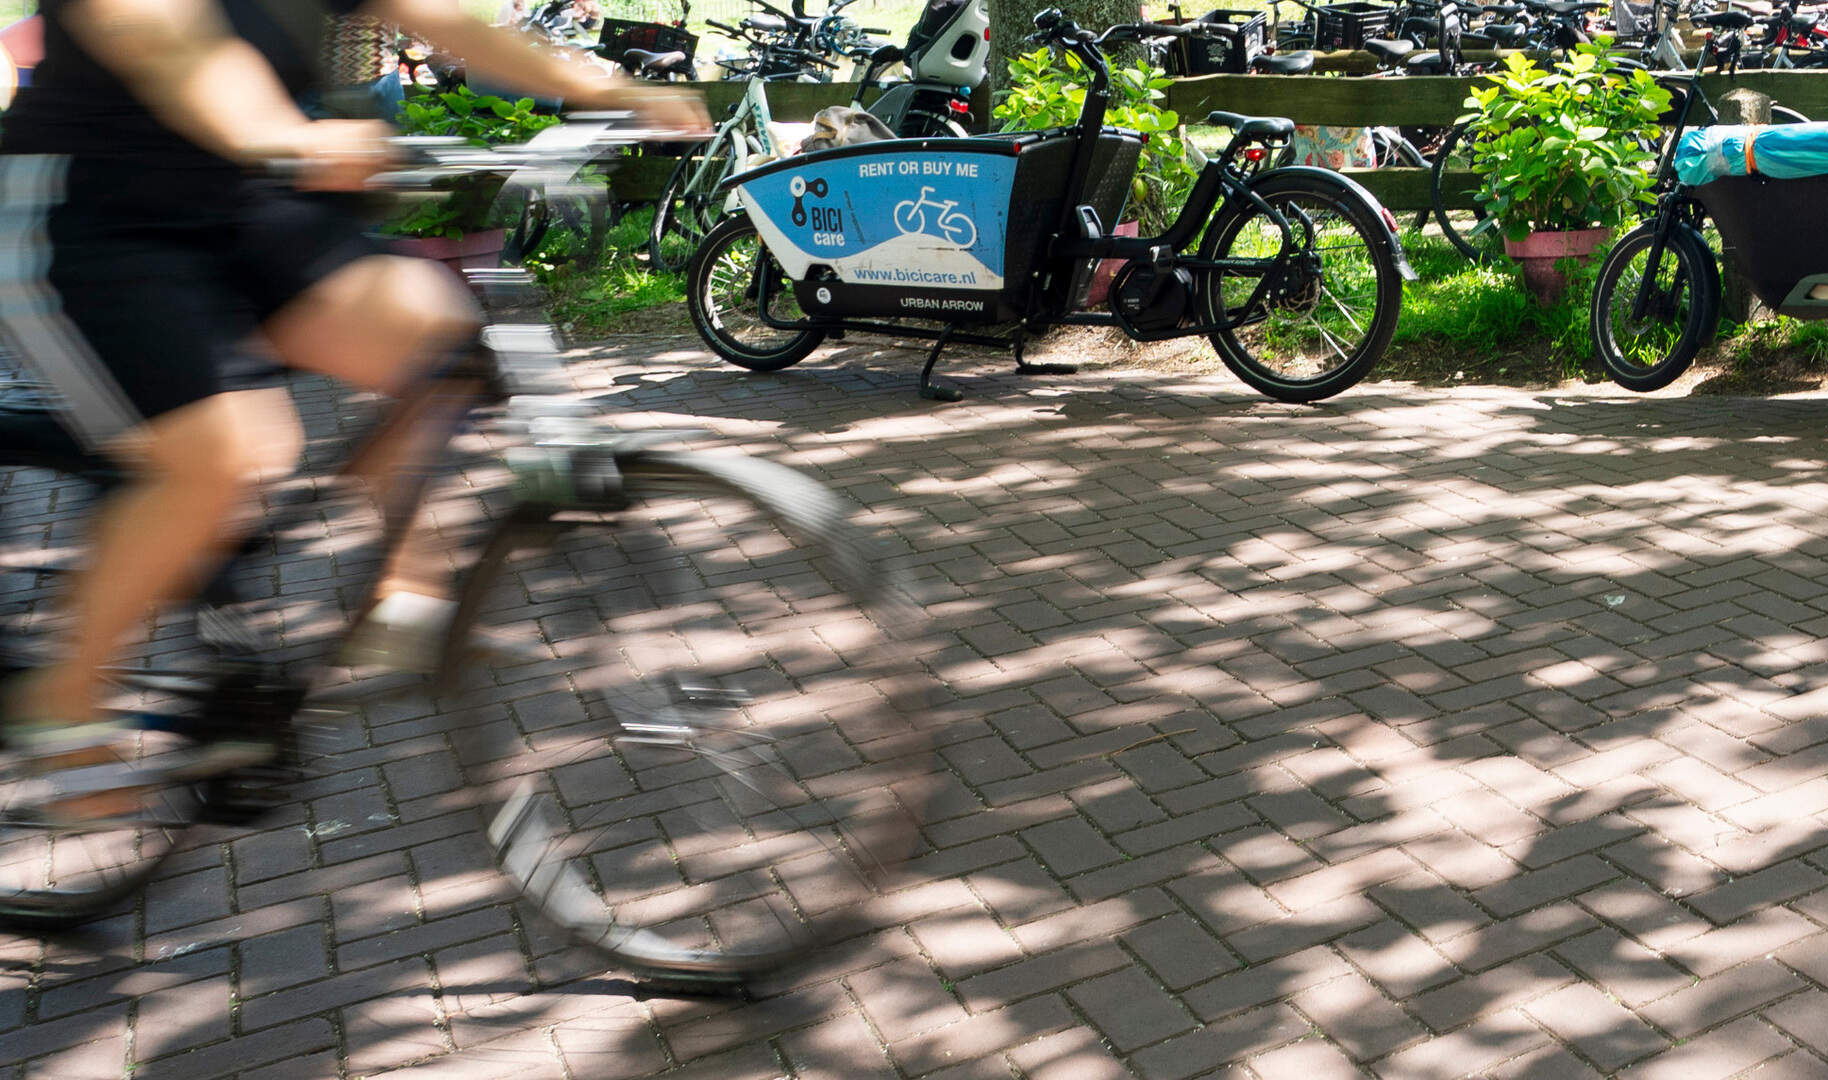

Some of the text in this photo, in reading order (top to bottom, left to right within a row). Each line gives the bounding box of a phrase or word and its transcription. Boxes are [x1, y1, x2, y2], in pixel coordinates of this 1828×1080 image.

[859, 161, 979, 178] RENT OR BUY ME
[811, 207, 843, 232] BICI
[813, 232, 846, 247] care
[854, 269, 977, 284] www.bicicare.nl
[900, 297, 984, 311] URBAN ARROW
